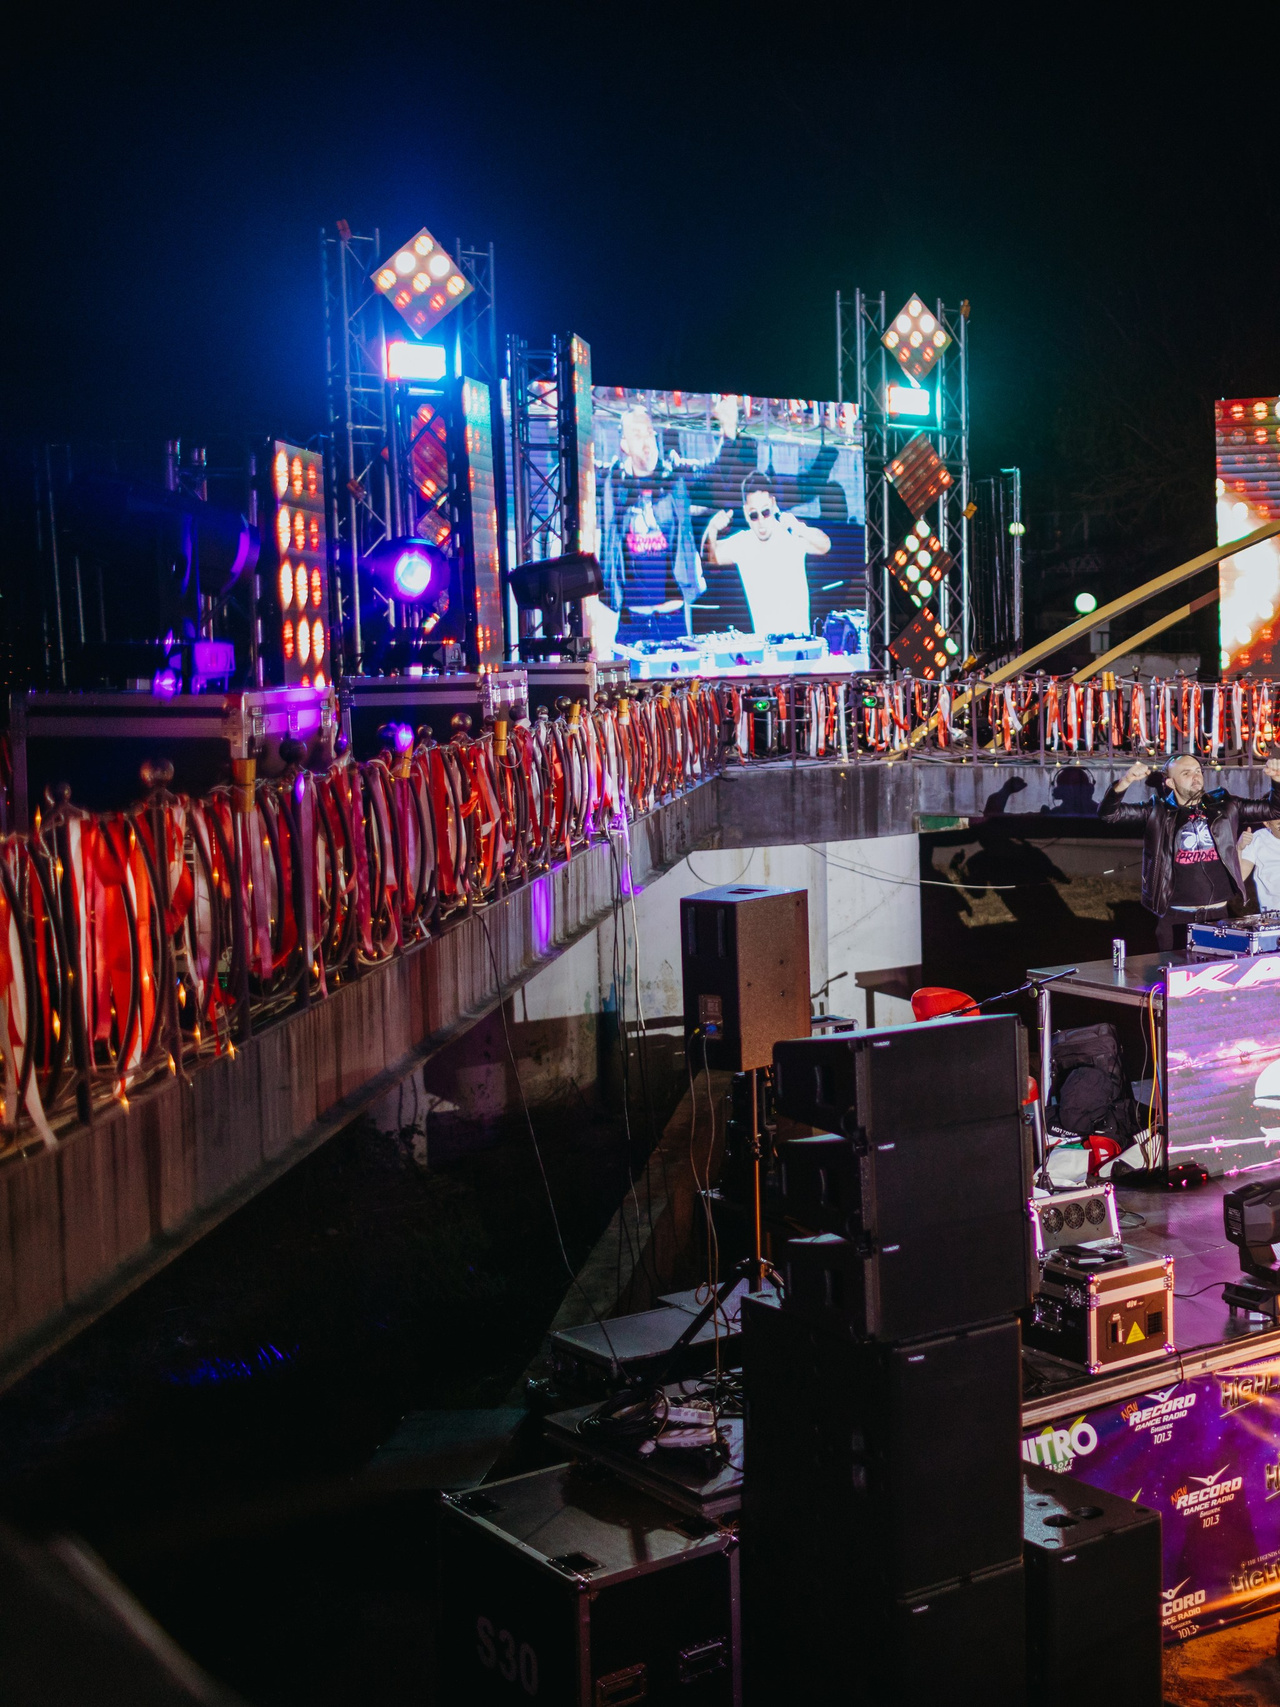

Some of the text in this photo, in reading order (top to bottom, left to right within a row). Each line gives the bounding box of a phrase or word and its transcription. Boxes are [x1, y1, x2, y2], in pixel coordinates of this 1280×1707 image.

[1129, 1393, 1196, 1427] RECORD
[1134, 1410, 1188, 1432] DANCE RADIO
[1176, 1477, 1242, 1510] RECORD
[1183, 1494, 1235, 1516] DANCE RADIO
[1162, 1589, 1206, 1616] CORD
[1162, 1607, 1201, 1627] NCE RADIO
[477, 1615, 538, 1696] S30
